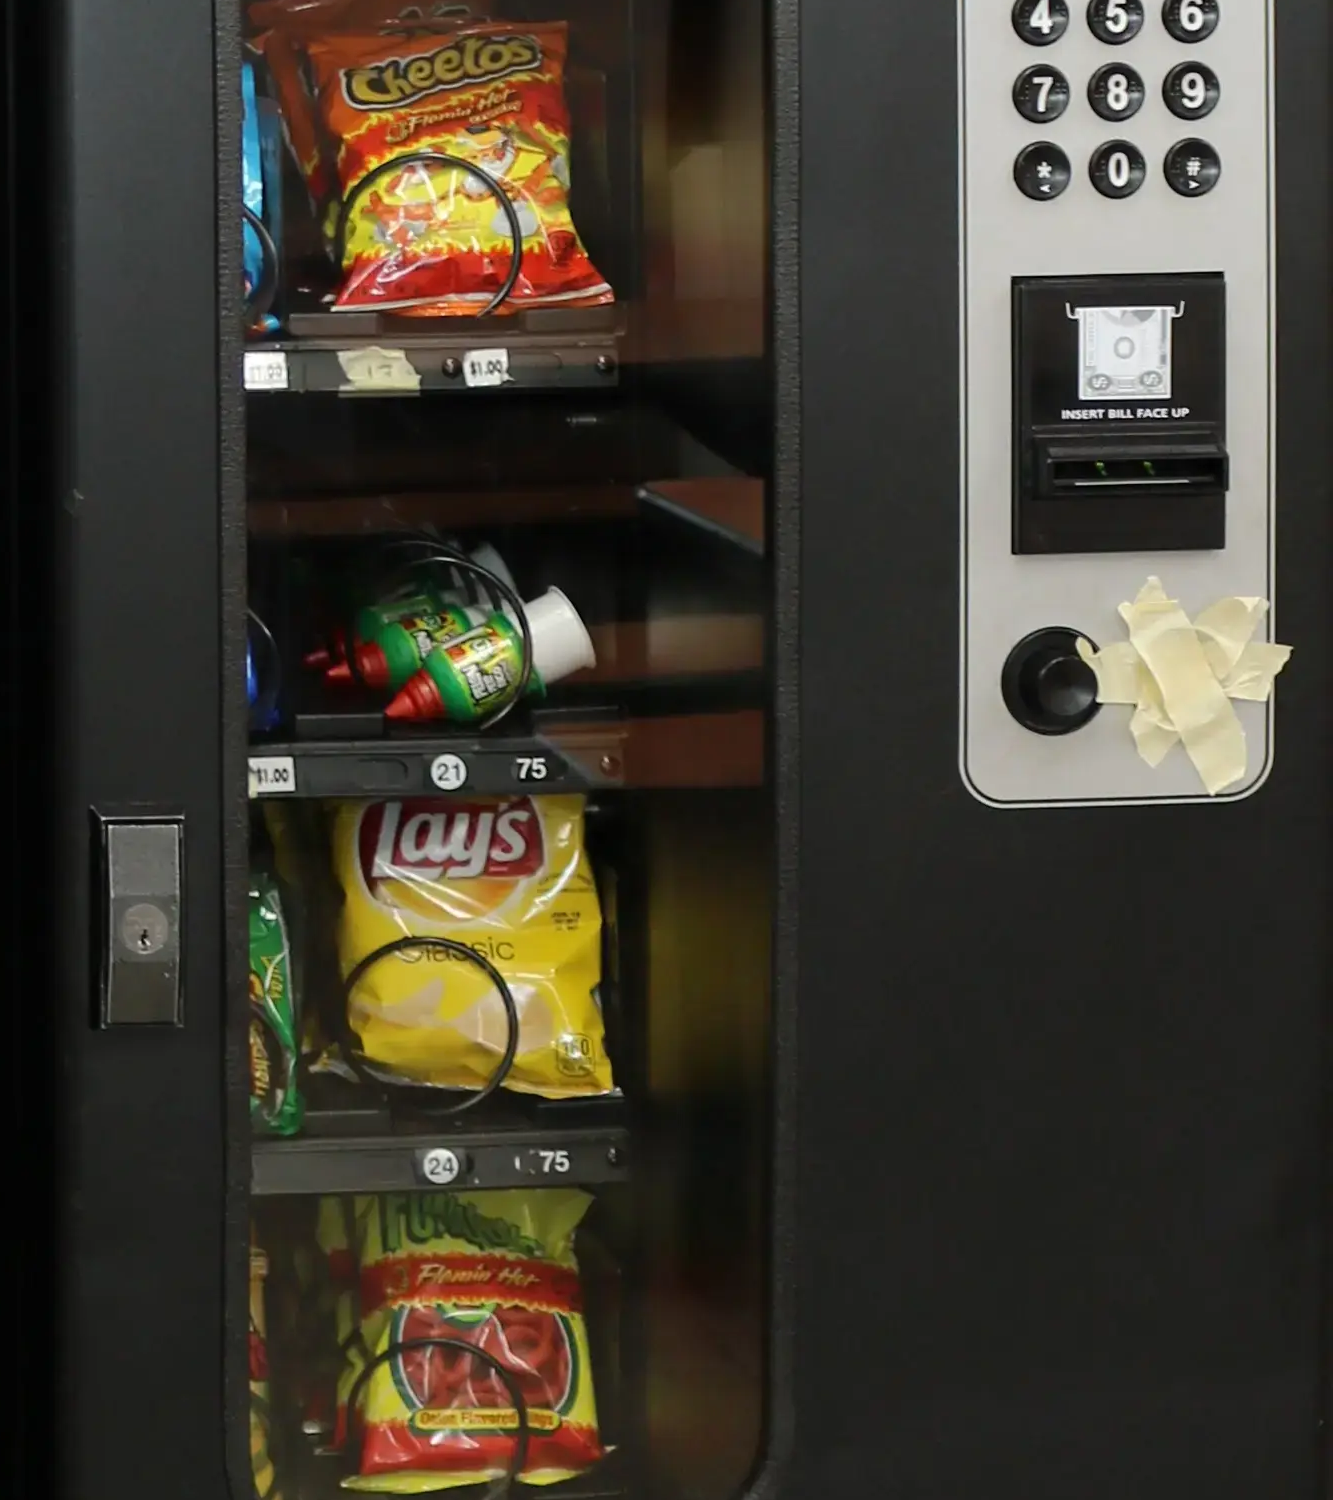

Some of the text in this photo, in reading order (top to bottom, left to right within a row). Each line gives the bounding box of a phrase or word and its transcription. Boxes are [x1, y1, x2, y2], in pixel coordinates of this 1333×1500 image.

[348, 35, 536, 103] Cheetos
[1032, 71, 1206, 113] 7 8 9
[1108, 151, 1130, 188] 0
[470, 359, 504, 377] $1.00
[1060, 407, 1191, 420] INSERT BILL FACE UP
[436, 758, 547, 782] 21 75
[372, 800, 531, 879] Lay's
[400, 935, 515, 965] Classic
[429, 1151, 570, 1176] 24 75
